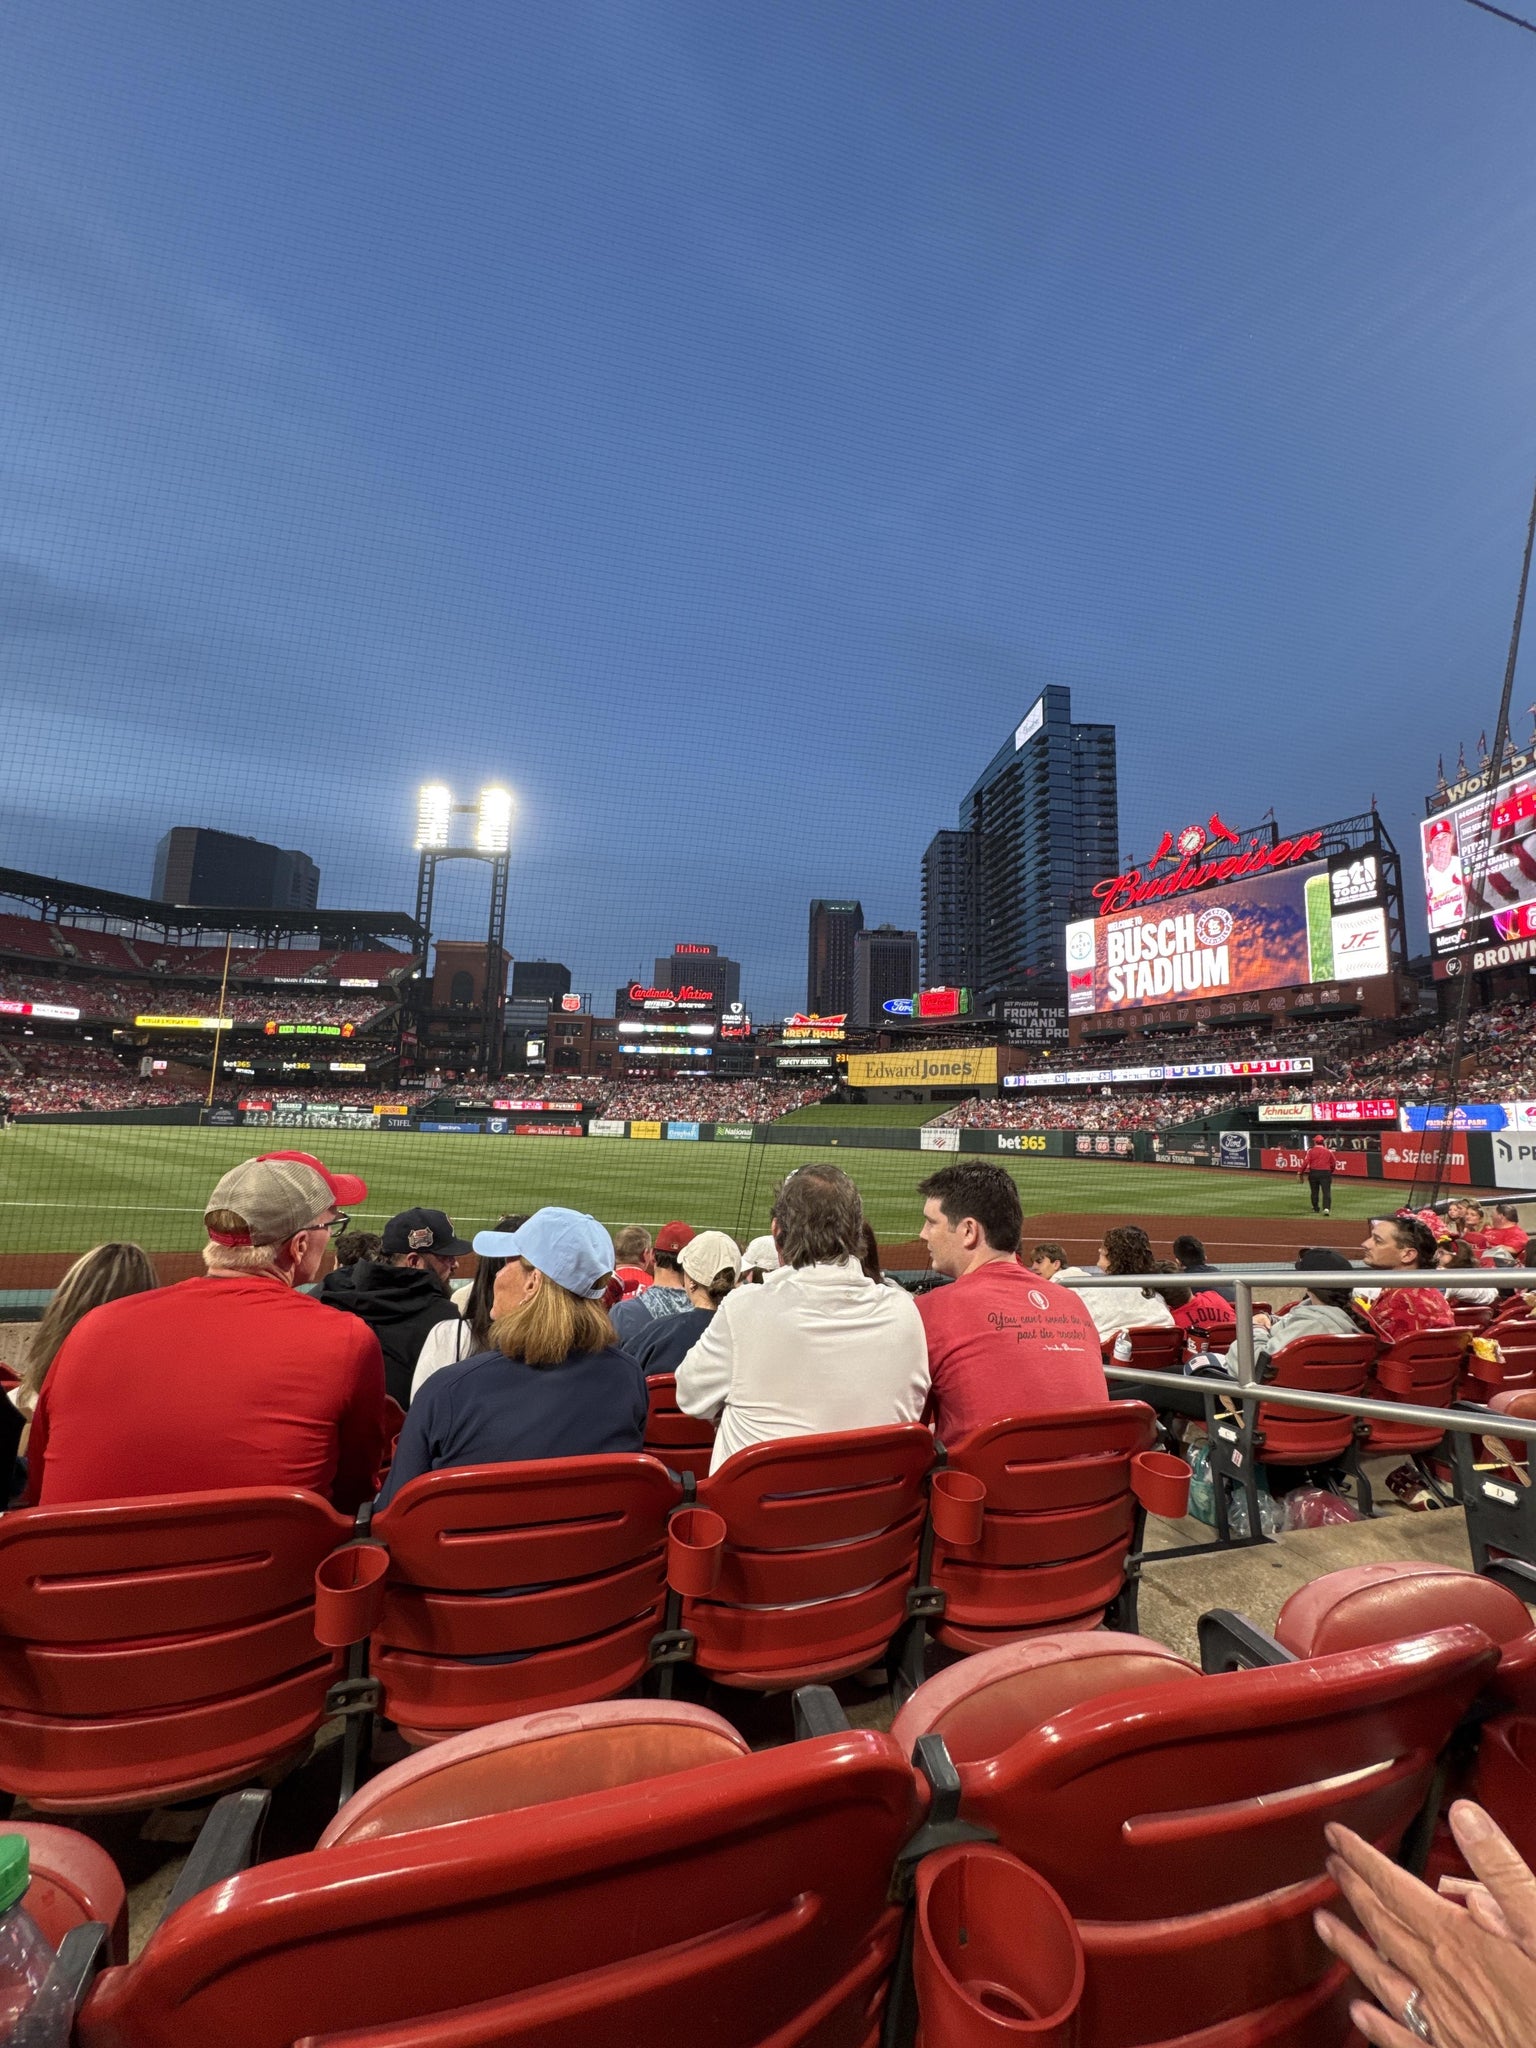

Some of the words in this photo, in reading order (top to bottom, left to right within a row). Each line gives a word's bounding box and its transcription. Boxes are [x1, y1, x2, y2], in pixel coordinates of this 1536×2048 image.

[1092, 832, 1322, 915] Budweiser
[1332, 857, 1376, 889] stl
[1333, 881, 1376, 898] TODAY
[1107, 913, 1196, 967] BUSCH
[676, 944, 710, 954] Hilton
[1107, 945, 1230, 1002] STADIUM
[630, 984, 674, 1000] Cardinals
[674, 985, 713, 1001] Nation
[1003, 1008, 1038, 1018] FROM
[1041, 1008, 1066, 1018] THE
[1177, 1009, 1189, 1021] 17
[1242, 1000, 1259, 1013] 24
[1268, 997, 1286, 1010] 42
[1004, 1018, 1027, 1027] OU
[1030, 1018, 1056, 1028] AND
[296, 1025, 317, 1034] MAC
[318, 1025, 340, 1035] LAND
[812, 1030, 846, 1039] HOUSE
[866, 1060, 919, 1079] Edward
[922, 1060, 972, 1079] Jones
[1263, 1105, 1305, 1116] Schnucks
[387, 1118, 411, 1127] STIFEL
[1468, 1118, 1487, 1126] PARK
[725, 1126, 752, 1136] National
[998, 1133, 1046, 1150] bet365
[1226, 1134, 1242, 1148] Ford
[1156, 1154, 1171, 1163] BUSCH
[1172, 1156, 1195, 1164] STADIUM
[1402, 1148, 1465, 1166] StateFrm
[1186, 1307, 1230, 1325] LOUIS
[1040, 1327, 1055, 1339] the
[1496, 1488, 1504, 1497] D
